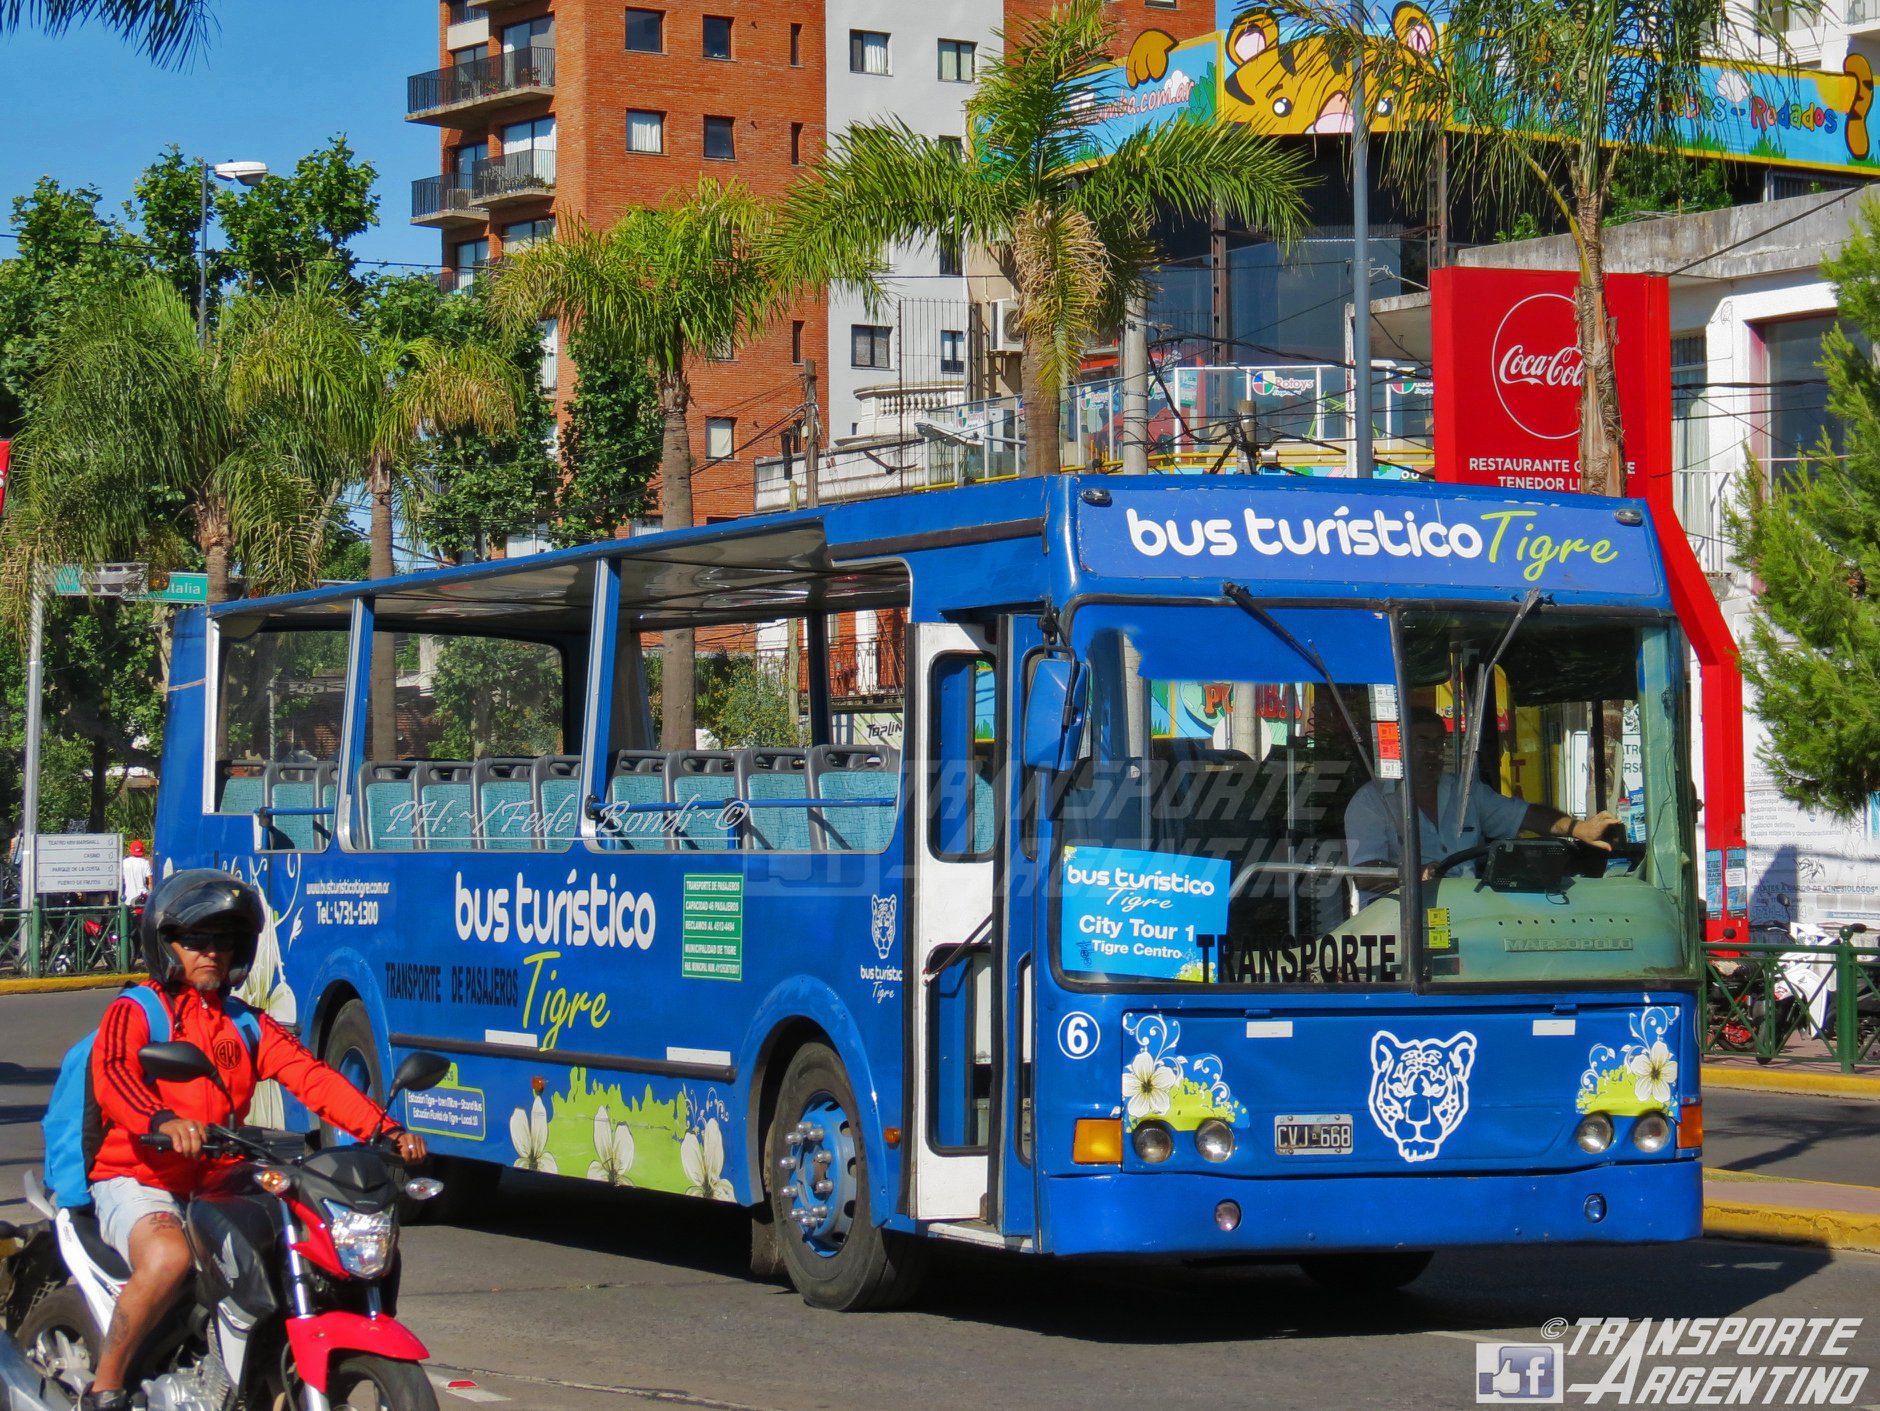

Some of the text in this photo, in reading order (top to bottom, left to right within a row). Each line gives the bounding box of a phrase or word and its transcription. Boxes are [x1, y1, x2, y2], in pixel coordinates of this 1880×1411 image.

[1500, 344, 1581, 386] Coca-Col
[1469, 457, 1570, 472] RESTAURANTE
[1498, 476, 1564, 490] TENEDOR
[1126, 505, 1618, 582] bus turístico Tigre
[686, 880, 740, 891] TRANSPORTE DE PASAJEROS
[1067, 864, 1215, 897] bus turístico
[455, 868, 656, 950] bus turístico
[715, 901, 739, 912] PASAJEROS
[1106, 886, 1174, 912] Tigre
[1079, 914, 1195, 942] City Tour 1
[724, 945, 736, 955] TIGRE
[1091, 939, 1129, 956] Tigre
[1133, 942, 1183, 960] Centro
[1196, 934, 1396, 983] TRANSPORTE
[385, 962, 518, 1008] TRANSPORTE DE PASAJEROS
[860, 964, 874, 980] bus
[523, 951, 611, 1053] Tigre
[872, 981, 895, 1004] Tigre
[1066, 1016, 1089, 1055] 6
[1277, 1126, 1308, 1148] CVJ
[1321, 1126, 1351, 1147] 668
